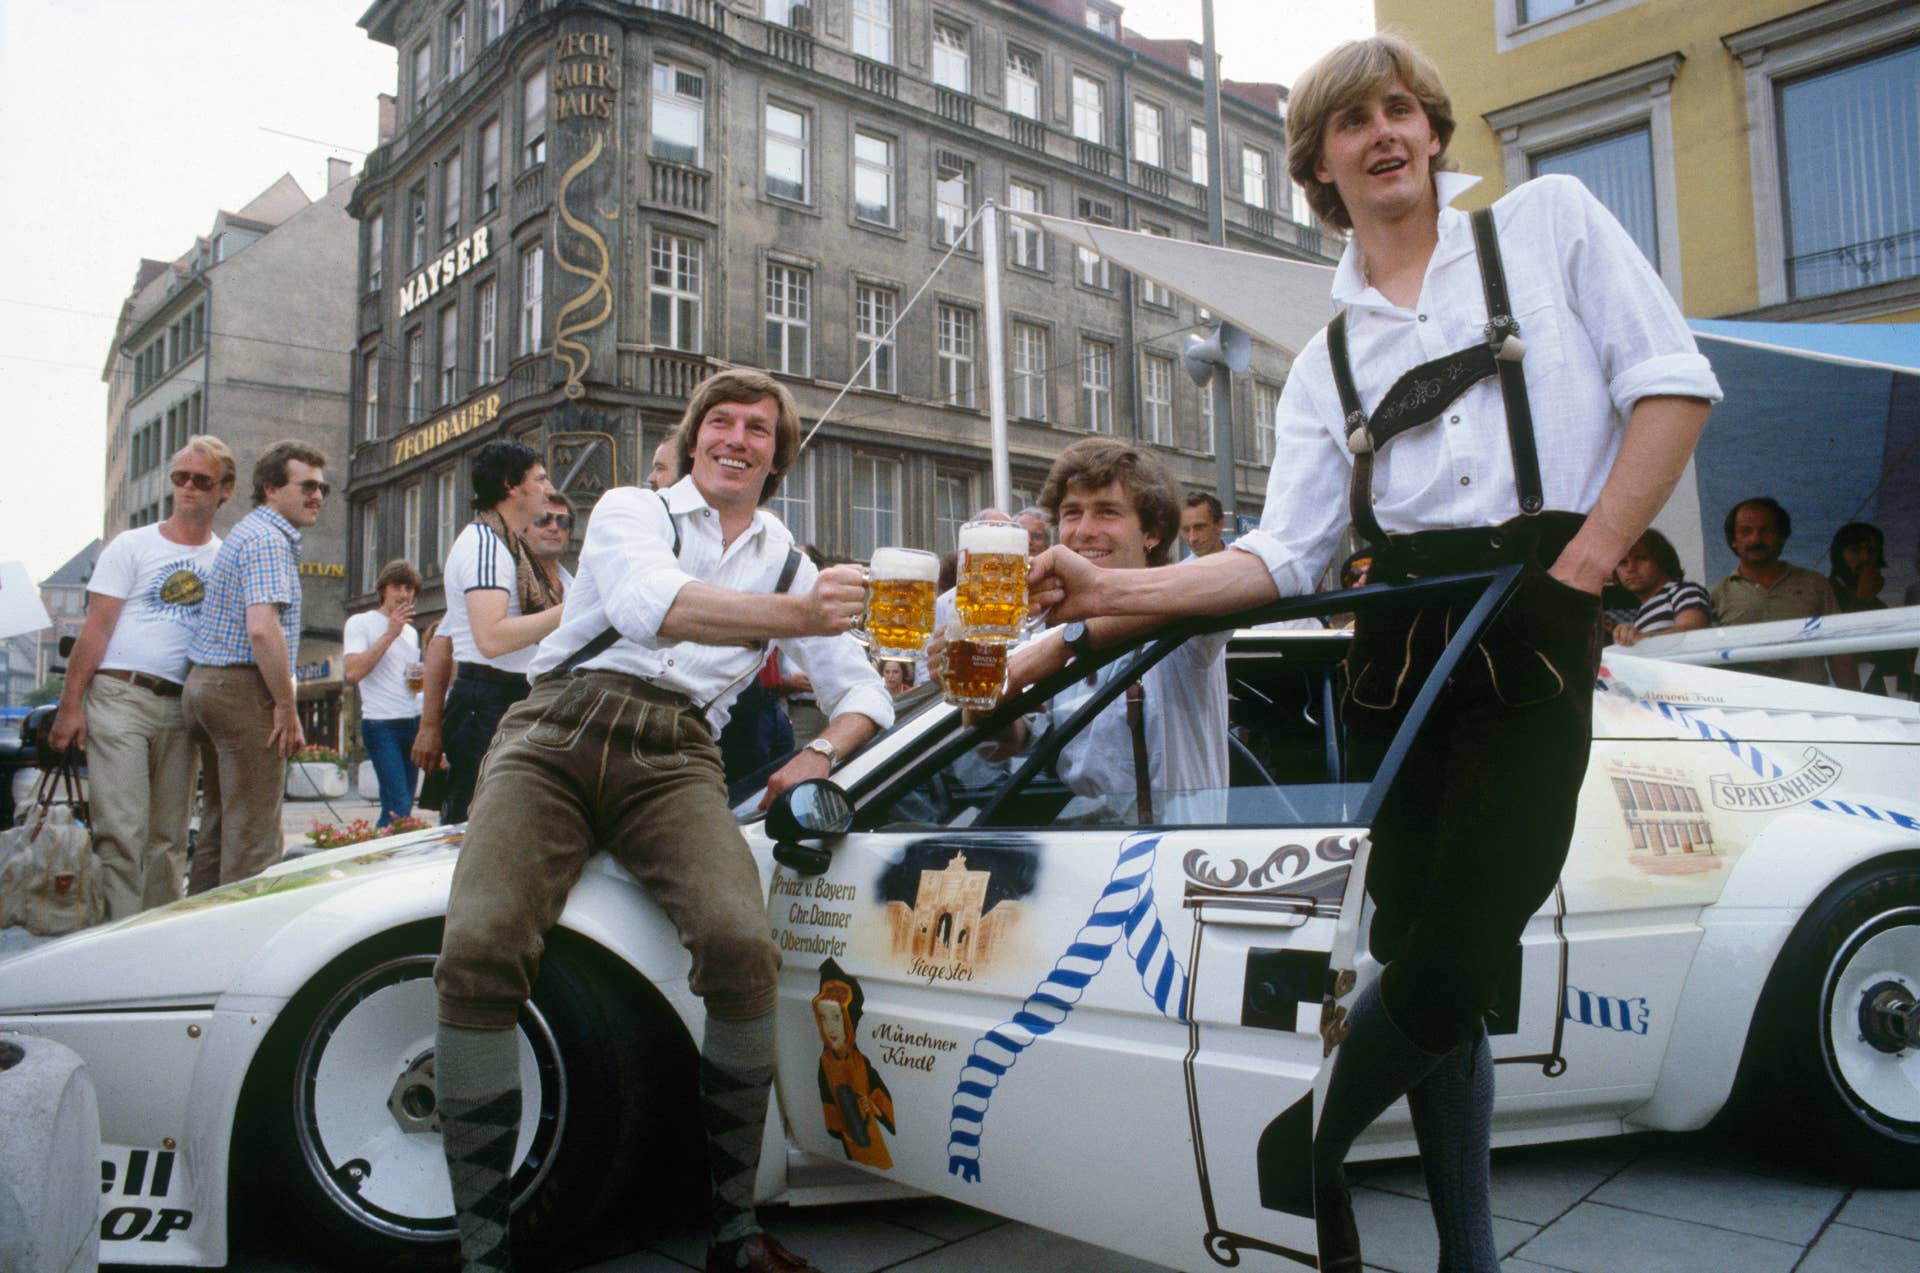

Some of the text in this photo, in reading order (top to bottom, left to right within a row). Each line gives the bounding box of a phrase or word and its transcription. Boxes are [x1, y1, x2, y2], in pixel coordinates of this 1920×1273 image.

[556, 92, 610, 119] HAUS
[400, 226, 489, 317] MAYSER
[395, 394, 500, 465] ZECHBAUER
[1721, 759, 1836, 806] SPATENHAUS
[771, 874, 804, 896] Prinz
[814, 876, 857, 901] Bayern
[809, 903, 852, 928] Danner
[780, 928, 848, 957] Oberndorfer
[871, 1023, 959, 1052] Münchner
[879, 1043, 936, 1073] Kindl
